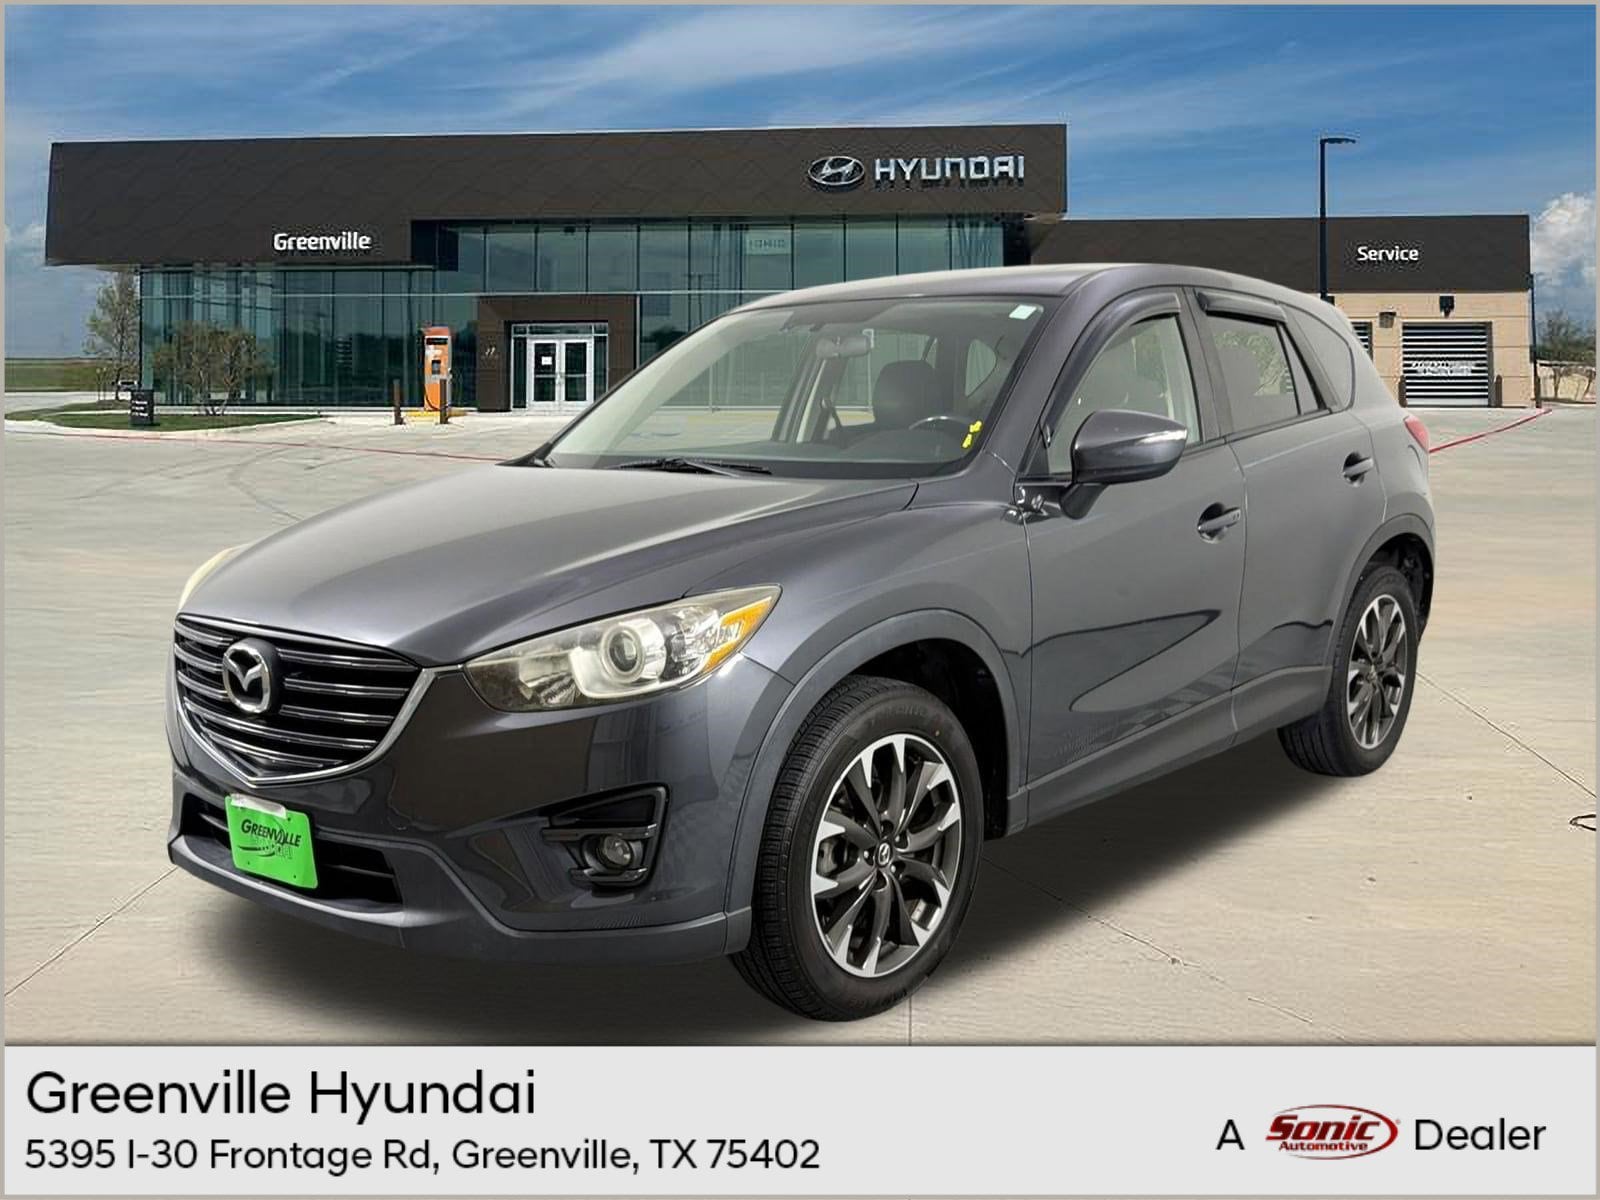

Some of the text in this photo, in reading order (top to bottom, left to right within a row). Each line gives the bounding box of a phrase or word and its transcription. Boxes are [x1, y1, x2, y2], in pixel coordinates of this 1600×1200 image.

[875, 155, 1025, 181] HYUNDAI
[273, 231, 371, 251] Greenville
[1356, 245, 1419, 262] Service
